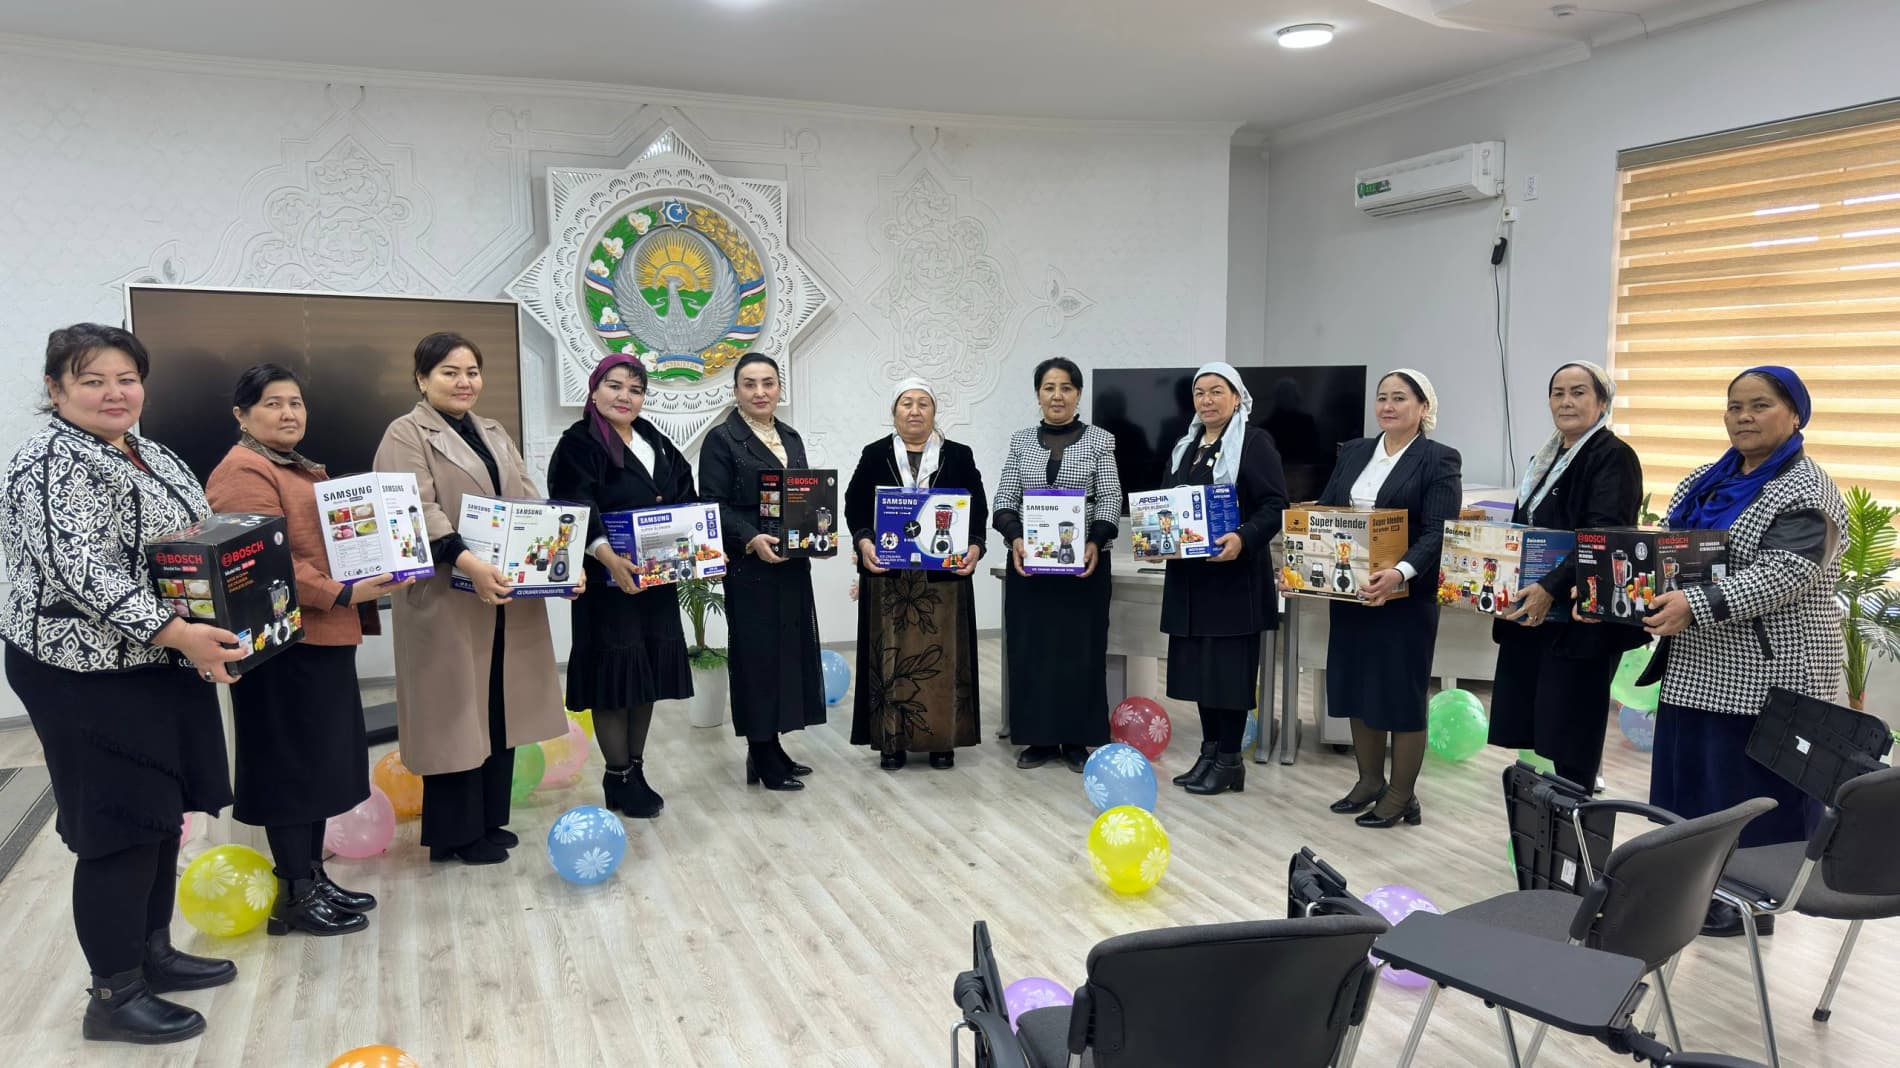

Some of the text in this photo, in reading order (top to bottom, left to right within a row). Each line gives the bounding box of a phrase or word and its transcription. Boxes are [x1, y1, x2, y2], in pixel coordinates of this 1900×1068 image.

[323, 485, 373, 502] SAMSUNG
[467, 503, 491, 513] SAMSUNG
[516, 508, 543, 516] SAMSUNG
[640, 514, 670, 525] SAMSUNG
[1310, 515, 1367, 529] Super blender
[1373, 515, 1404, 527] Super blender
[1584, 535, 1606, 544] BOSCH
[232, 540, 264, 562] BOSCH
[166, 553, 203, 565] BOSCH
